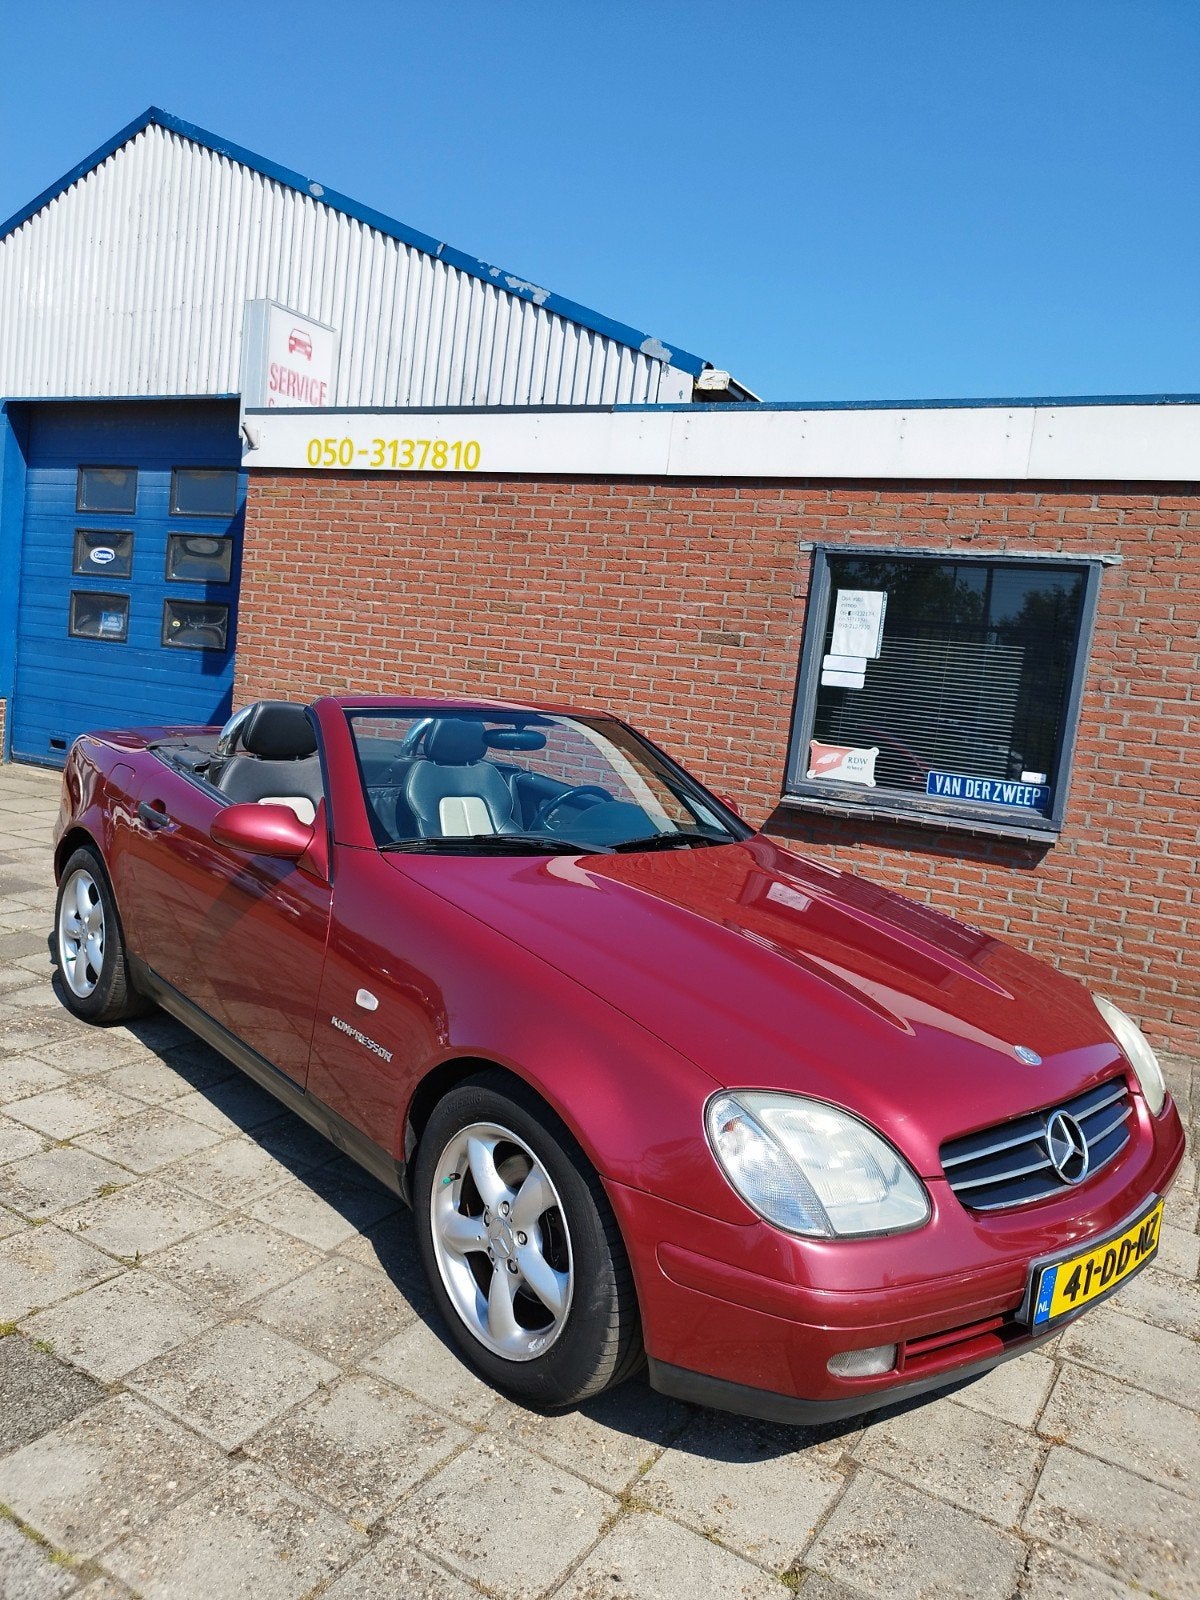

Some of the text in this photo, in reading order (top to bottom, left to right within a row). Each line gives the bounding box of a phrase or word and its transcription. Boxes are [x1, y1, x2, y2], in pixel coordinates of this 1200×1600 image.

[269, 363, 327, 407] SERVICE
[306, 438, 481, 470] 050-3137810
[847, 757, 868, 765] RDW
[935, 775, 1041, 806] VAN DER ZWEEP
[331, 1016, 393, 1062] KOMPRESSOR
[1063, 1212, 1160, 1302] 41-DD-NZ
[1038, 1302, 1050, 1314] NL
